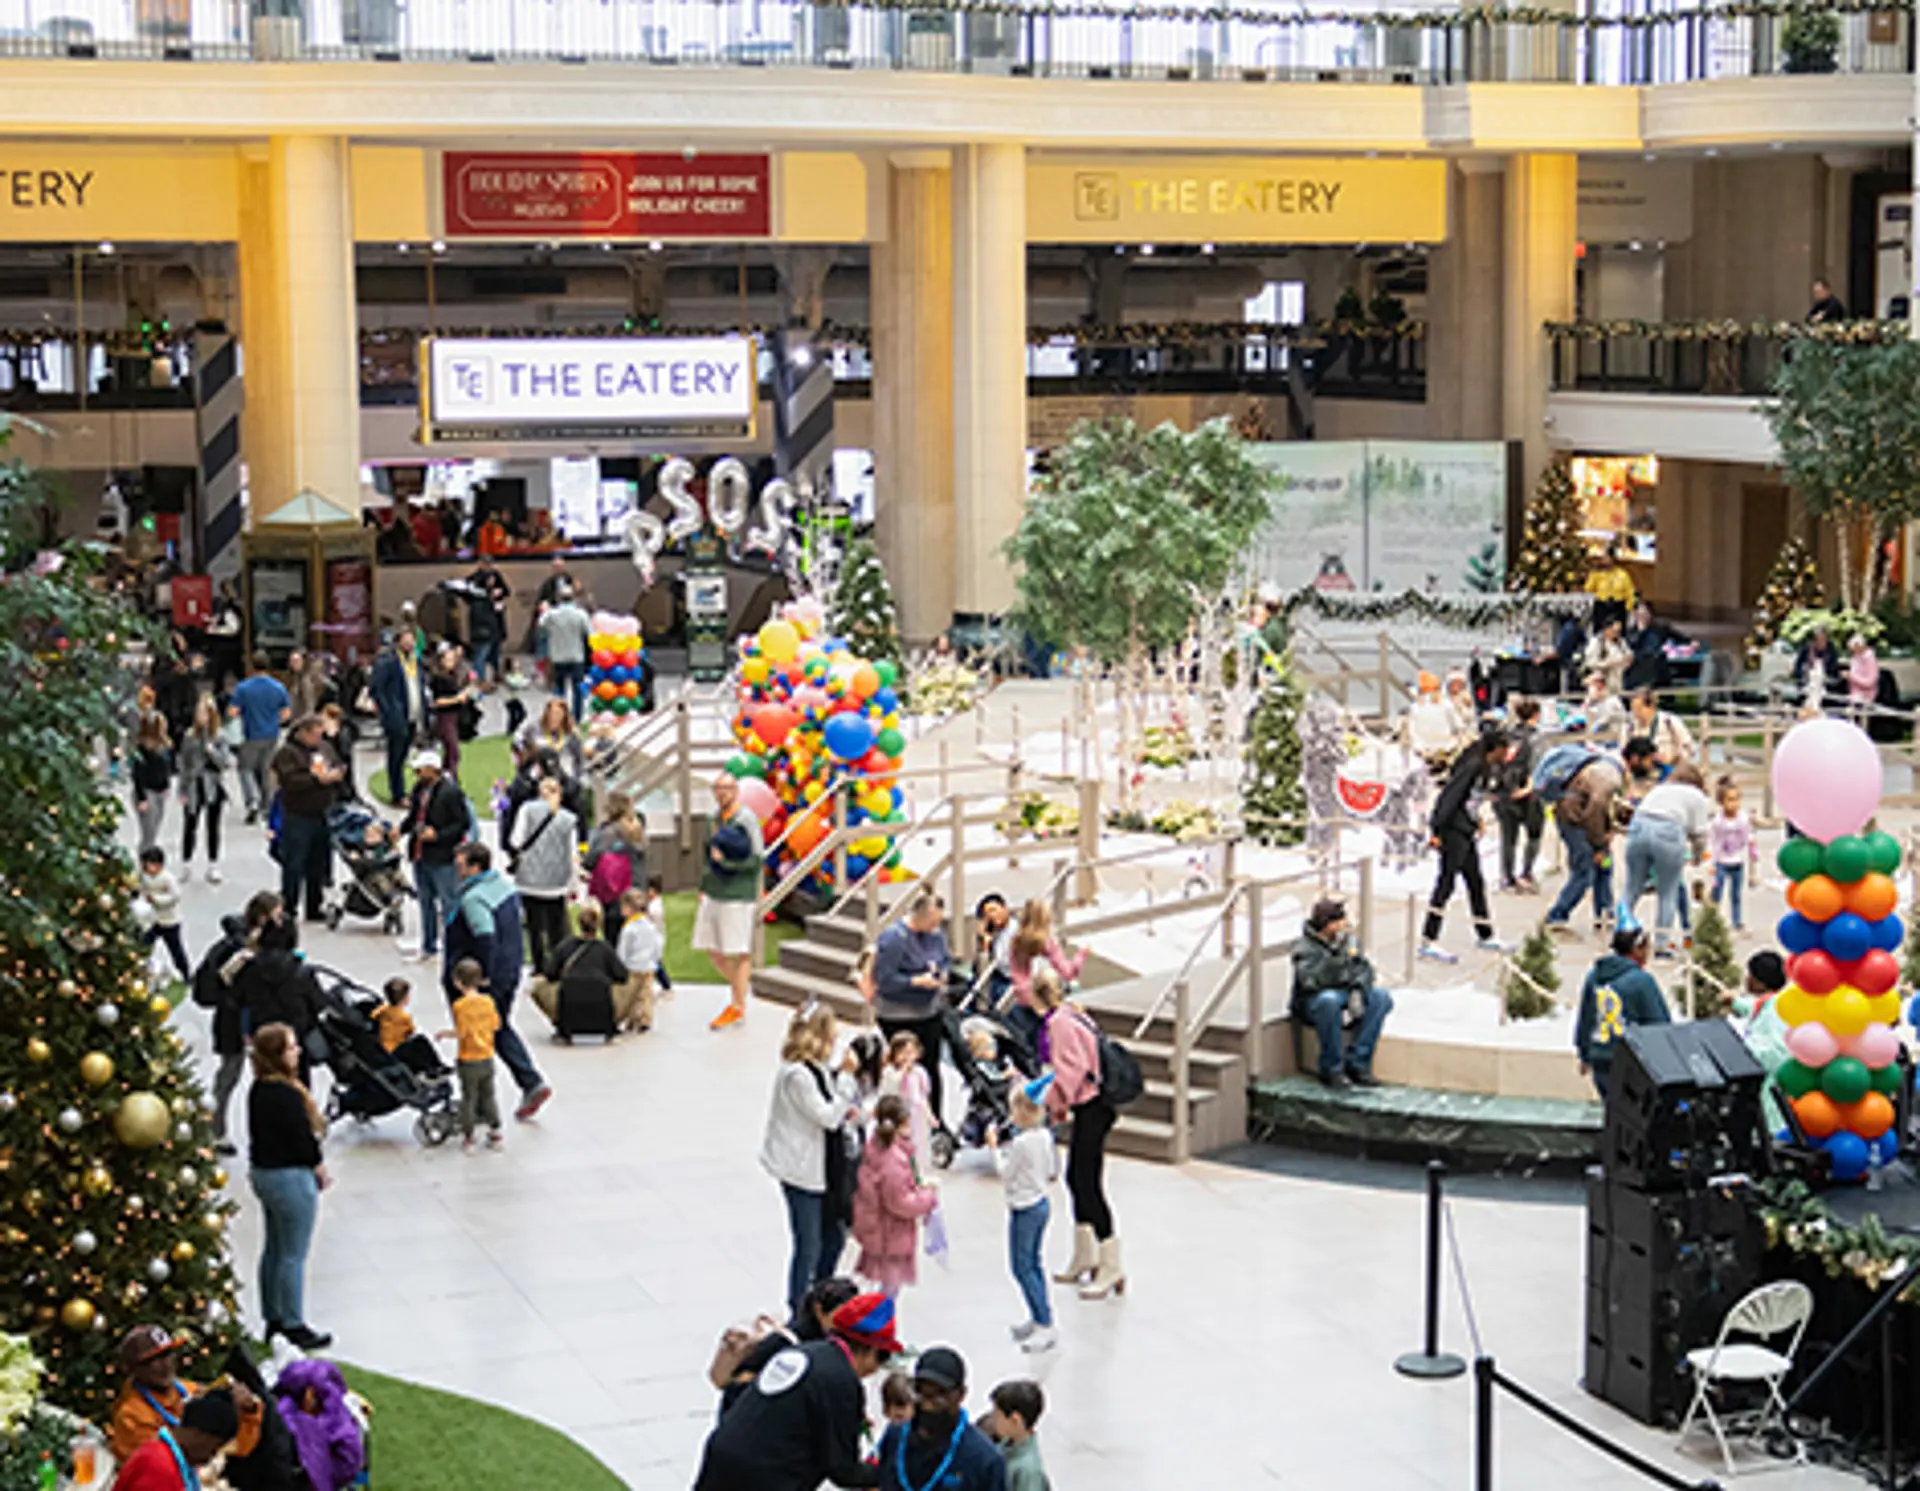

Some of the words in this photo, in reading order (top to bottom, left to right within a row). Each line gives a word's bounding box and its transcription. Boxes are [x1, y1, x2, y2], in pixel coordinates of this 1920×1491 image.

[0, 171, 94, 207] ERY
[628, 176, 662, 192] JOIN
[665, 176, 683, 192] US
[686, 176, 716, 192] FOR
[719, 176, 758, 193] SOME
[1127, 179, 1198, 213] THE
[1209, 180, 1342, 214] EATERY
[628, 197, 688, 213] HOLIDAY
[693, 197, 746, 213] CHEER!
[502, 362, 582, 397] THE
[596, 361, 740, 397] EATERY
